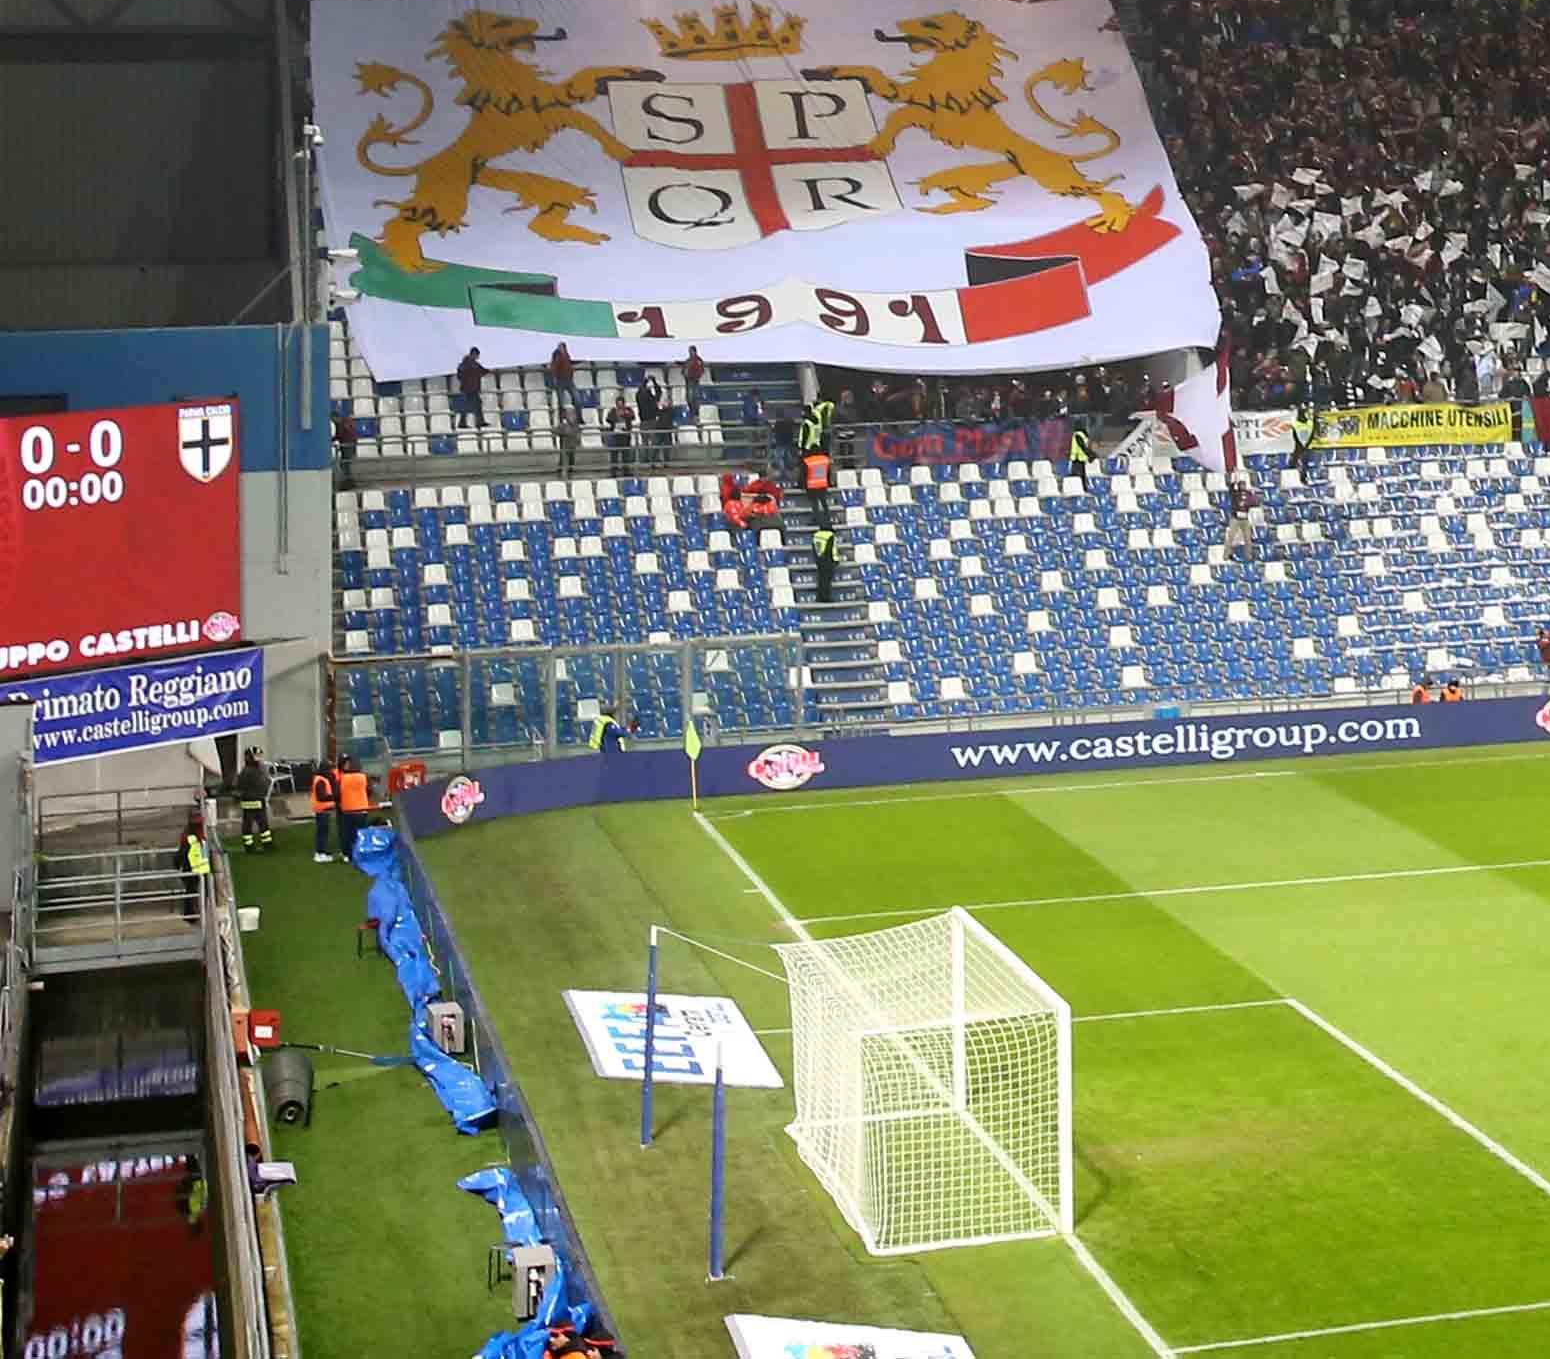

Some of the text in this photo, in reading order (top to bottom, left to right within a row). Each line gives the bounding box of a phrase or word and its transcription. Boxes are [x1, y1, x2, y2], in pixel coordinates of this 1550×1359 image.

[641, 90, 847, 145] S P
[648, 176, 881, 231] Q R
[617, 288, 951, 345] 1991
[1367, 408, 1444, 429] MACCHINE
[1448, 407, 1510, 428] UTENSILI
[22, 470, 124, 511] 00:00
[79, 619, 200, 657] CASTELLI
[8, 666, 252, 723] rimato Reggiano
[950, 715, 1422, 769] www.castelligroup.com
